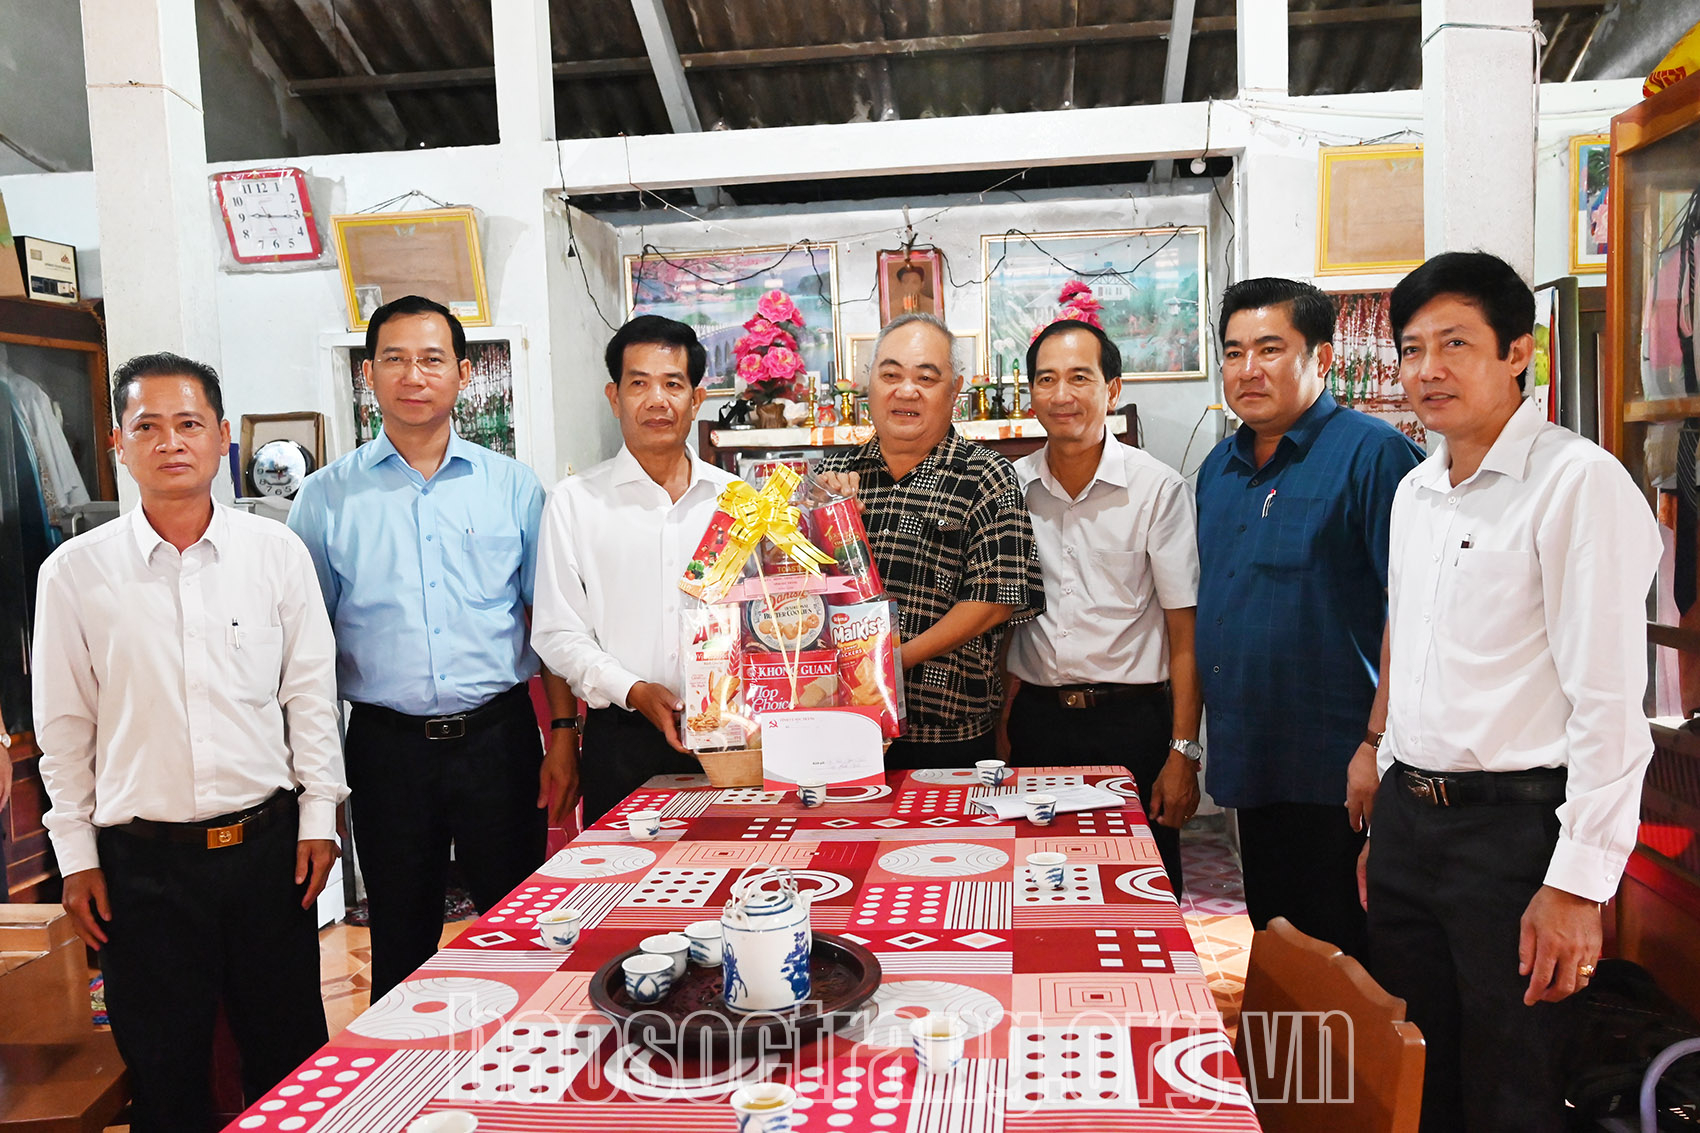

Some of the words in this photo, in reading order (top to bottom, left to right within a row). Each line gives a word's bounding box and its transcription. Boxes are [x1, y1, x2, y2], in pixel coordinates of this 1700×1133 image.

[242, 184, 252, 194] 11
[256, 183, 268, 193] 12
[274, 182, 280, 192] 1
[232, 196, 243, 207] 10
[290, 193, 296, 203] 2
[238, 213, 245, 222] 9
[294, 209, 300, 220] 3
[242, 229, 249, 239] 8
[297, 226, 304, 236] 4
[258, 240, 264, 250] 7
[273, 239, 279, 249] 6
[288, 238, 295, 248] 5
[763, 611, 786, 619] BUTER
[832, 617, 885, 645] Malkist
[801, 664, 832, 675] GUAN
[757, 685, 779, 701] Top
[752, 698, 793, 713] Choic
